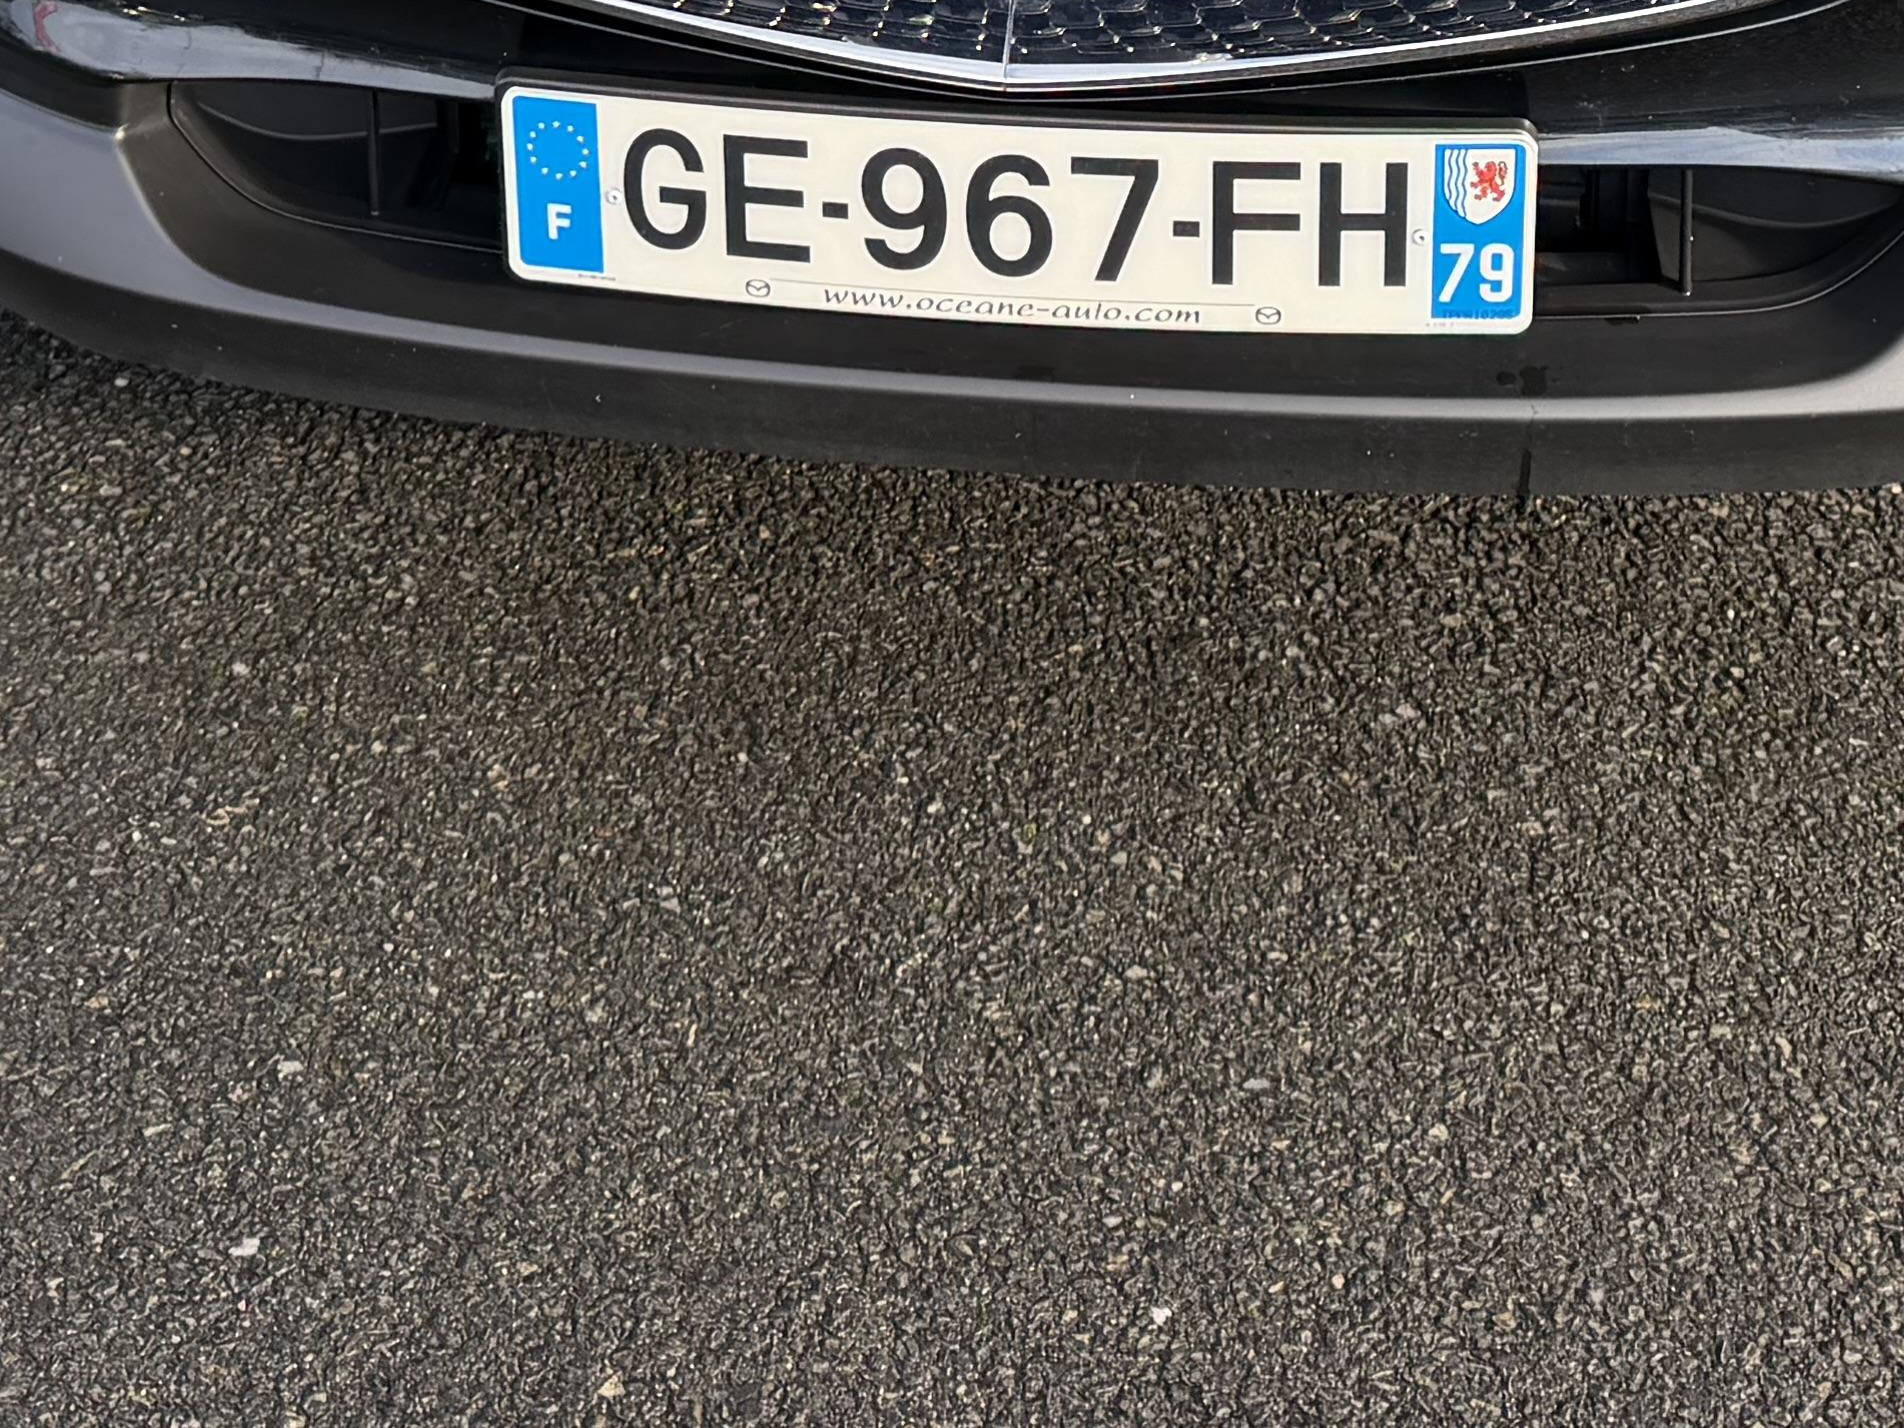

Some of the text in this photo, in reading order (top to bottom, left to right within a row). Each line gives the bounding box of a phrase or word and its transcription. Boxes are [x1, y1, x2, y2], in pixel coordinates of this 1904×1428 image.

[546, 202, 572, 240] F
[624, 128, 1408, 287] GE-967-FH
[1438, 242, 1515, 303] 79
